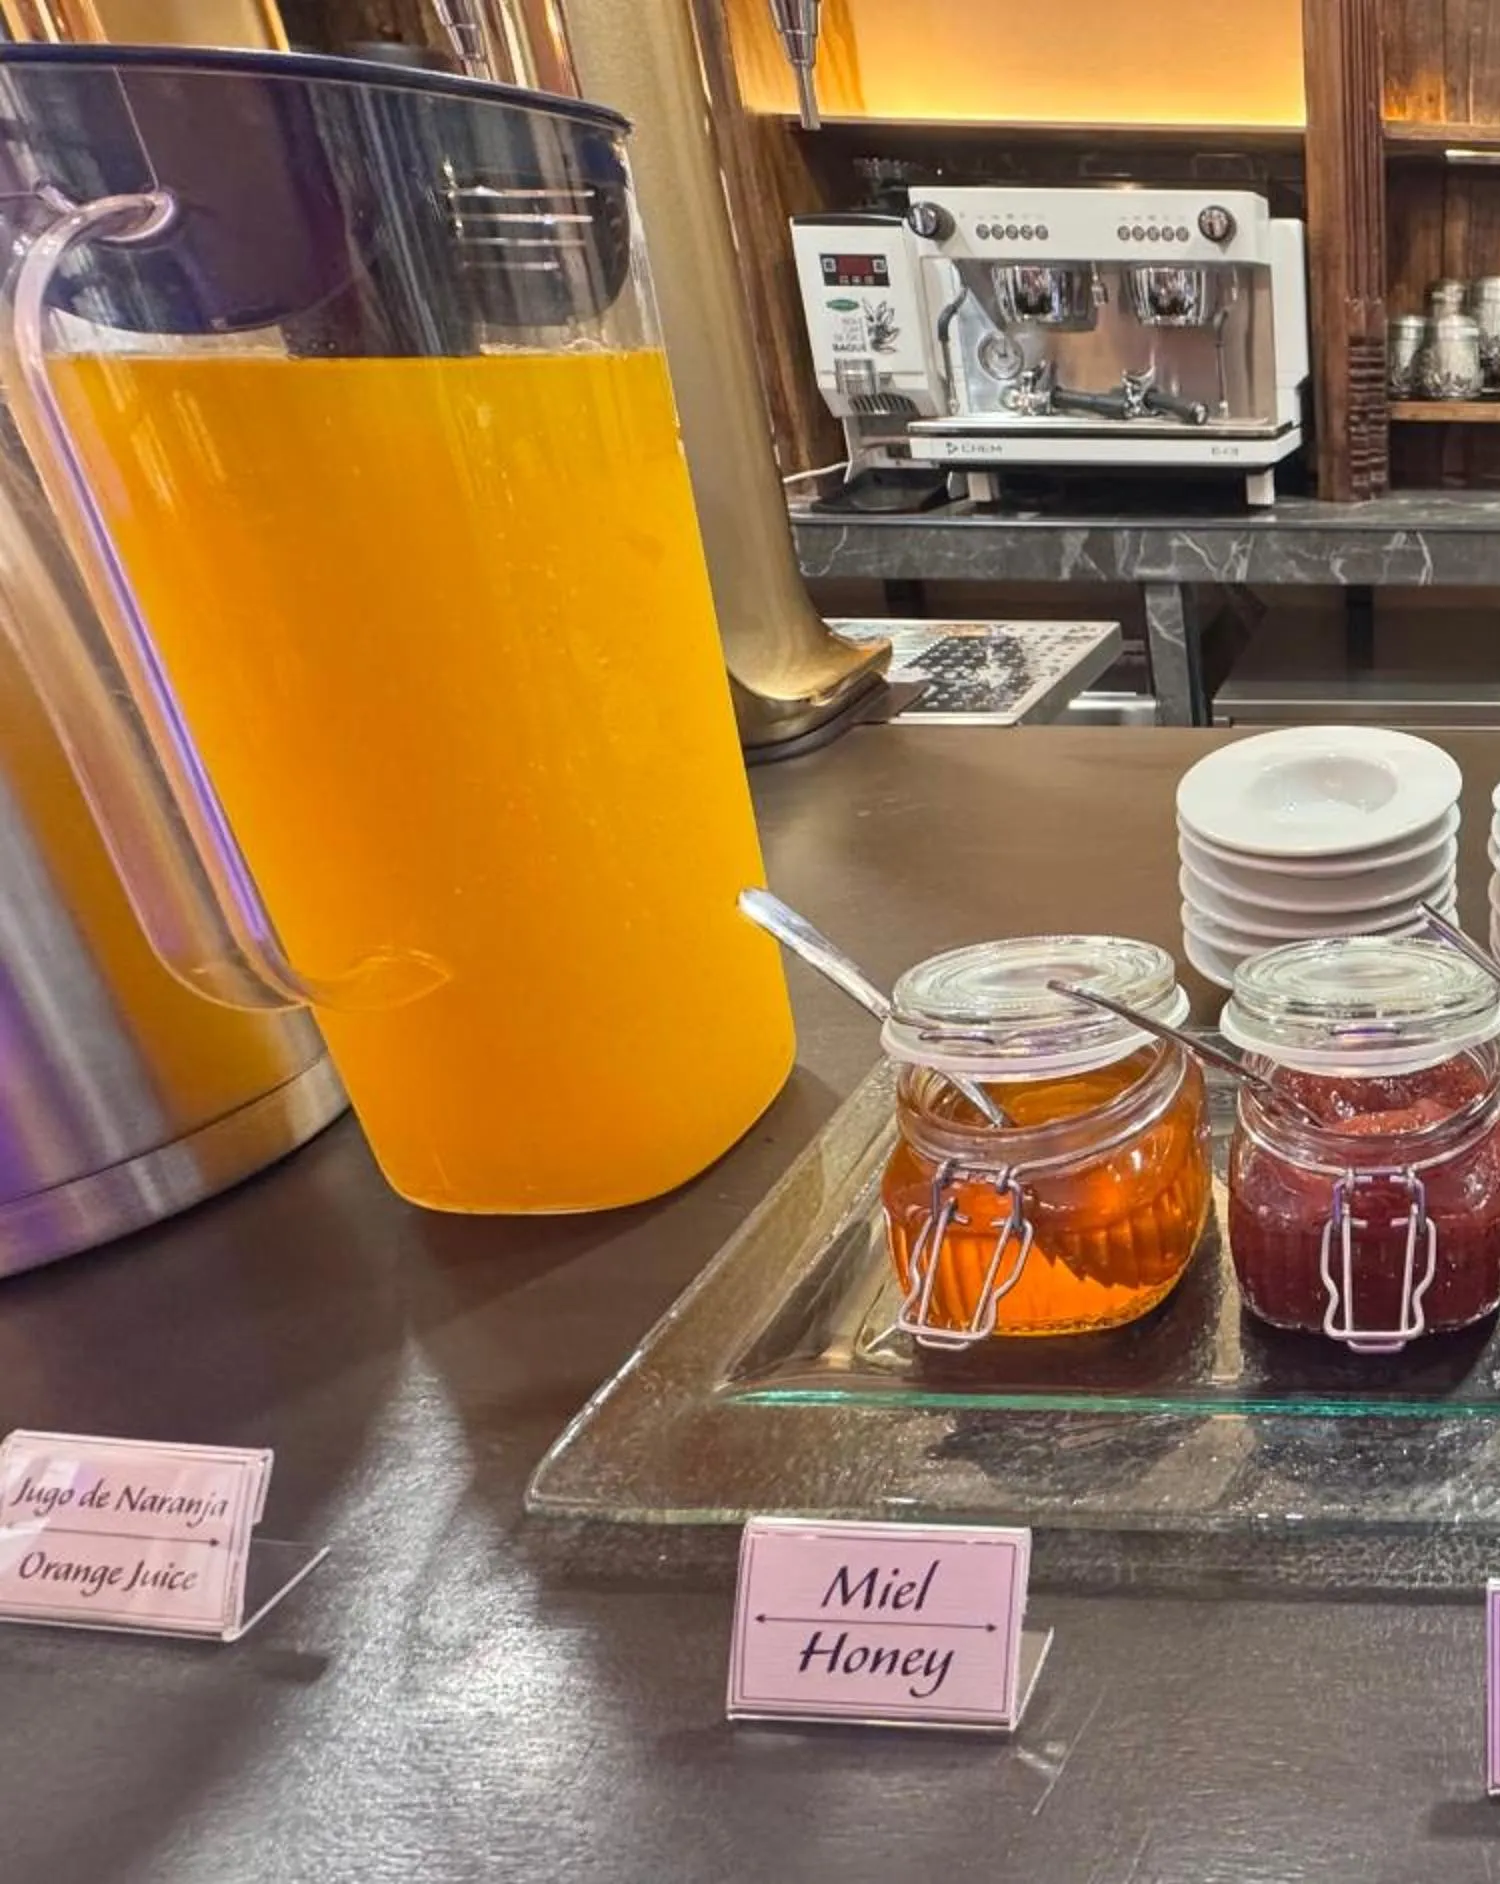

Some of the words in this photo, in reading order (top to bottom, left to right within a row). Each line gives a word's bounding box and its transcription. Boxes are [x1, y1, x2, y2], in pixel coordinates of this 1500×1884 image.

[10, 1477, 75, 1517] Jugo
[79, 1478, 110, 1509] de
[115, 1485, 229, 1528] Naranja
[18, 1552, 124, 1597] Orange
[120, 1560, 199, 1592] Juice
[820, 1559, 941, 1611] Miel
[798, 1631, 954, 1698] Honey
